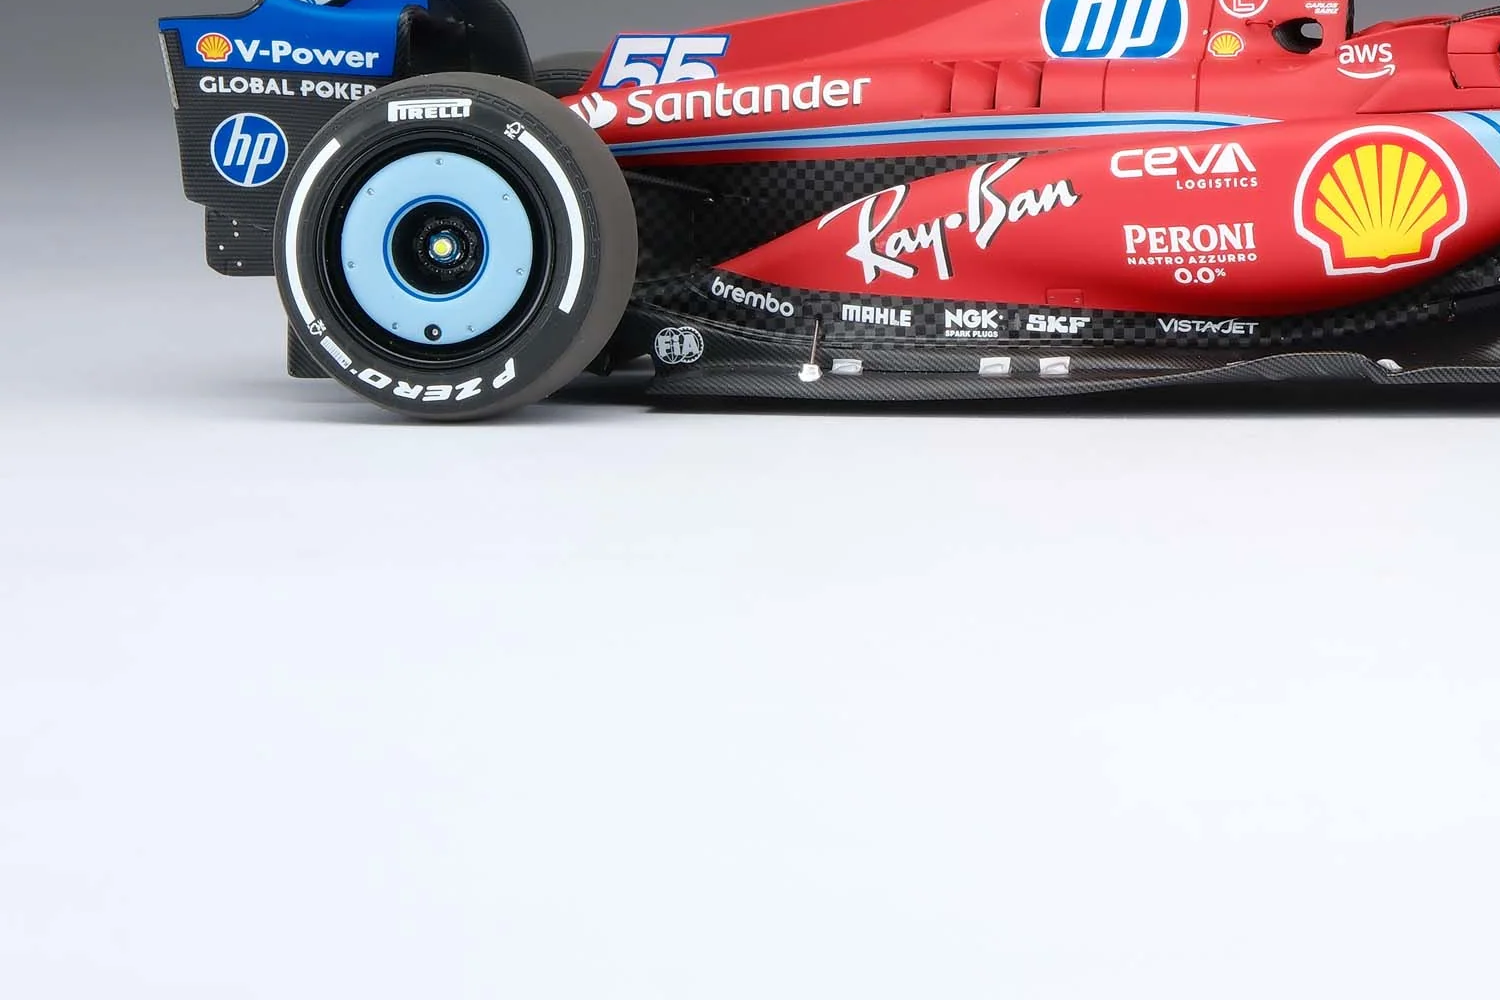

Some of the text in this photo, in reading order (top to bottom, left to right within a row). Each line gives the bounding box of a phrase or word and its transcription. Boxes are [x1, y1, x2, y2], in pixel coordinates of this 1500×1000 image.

[233, 39, 380, 69] V-Power
[600, 34, 731, 88] 55
[1338, 42, 1393, 65] aws
[200, 75, 295, 97] GLOBAL
[387, 98, 473, 122] PIRELLI
[626, 74, 872, 126] Santander
[223, 113, 275, 187] hp
[1176, 176, 1258, 190] LOGISTICS
[1123, 222, 1257, 254] PERONI
[1127, 252, 1258, 266] NASTRO AZZURRO
[1174, 266, 1227, 285] 0.0%
[711, 276, 795, 317] brembo
[842, 304, 912, 327] MAHLE
[944, 308, 999, 329] NGK
[1026, 313, 1091, 334] SKF
[944, 329, 999, 338] SPARK PLUGS
[357, 357, 516, 402] P ZERO
